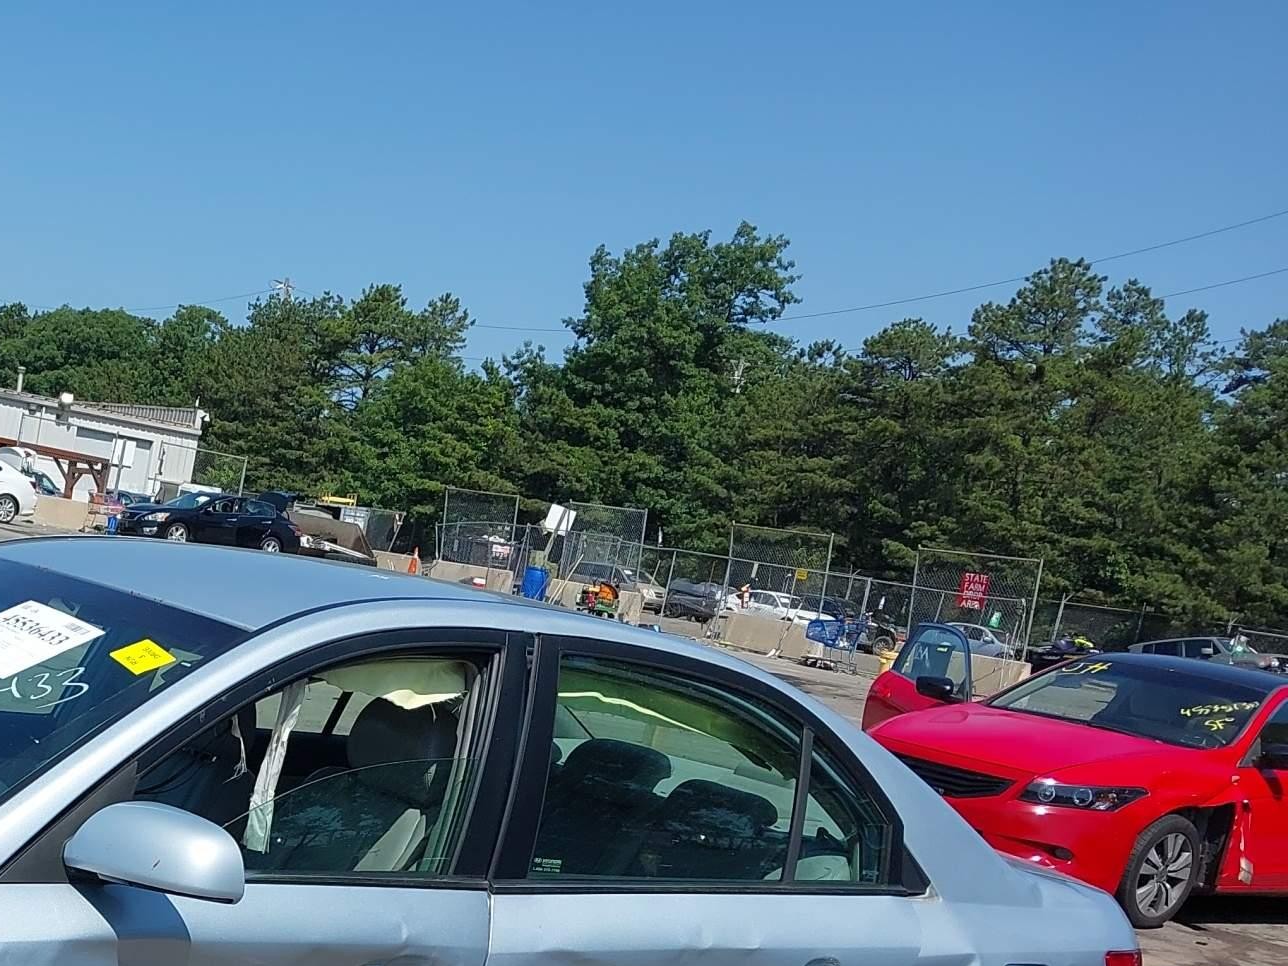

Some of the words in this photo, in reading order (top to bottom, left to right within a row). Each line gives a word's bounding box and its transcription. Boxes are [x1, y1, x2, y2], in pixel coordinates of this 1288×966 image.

[964, 573, 989, 584] STATE
[964, 582, 986, 592] FARM
[960, 600, 980, 609] AREA
[1, 614, 71, 646] 45536433
